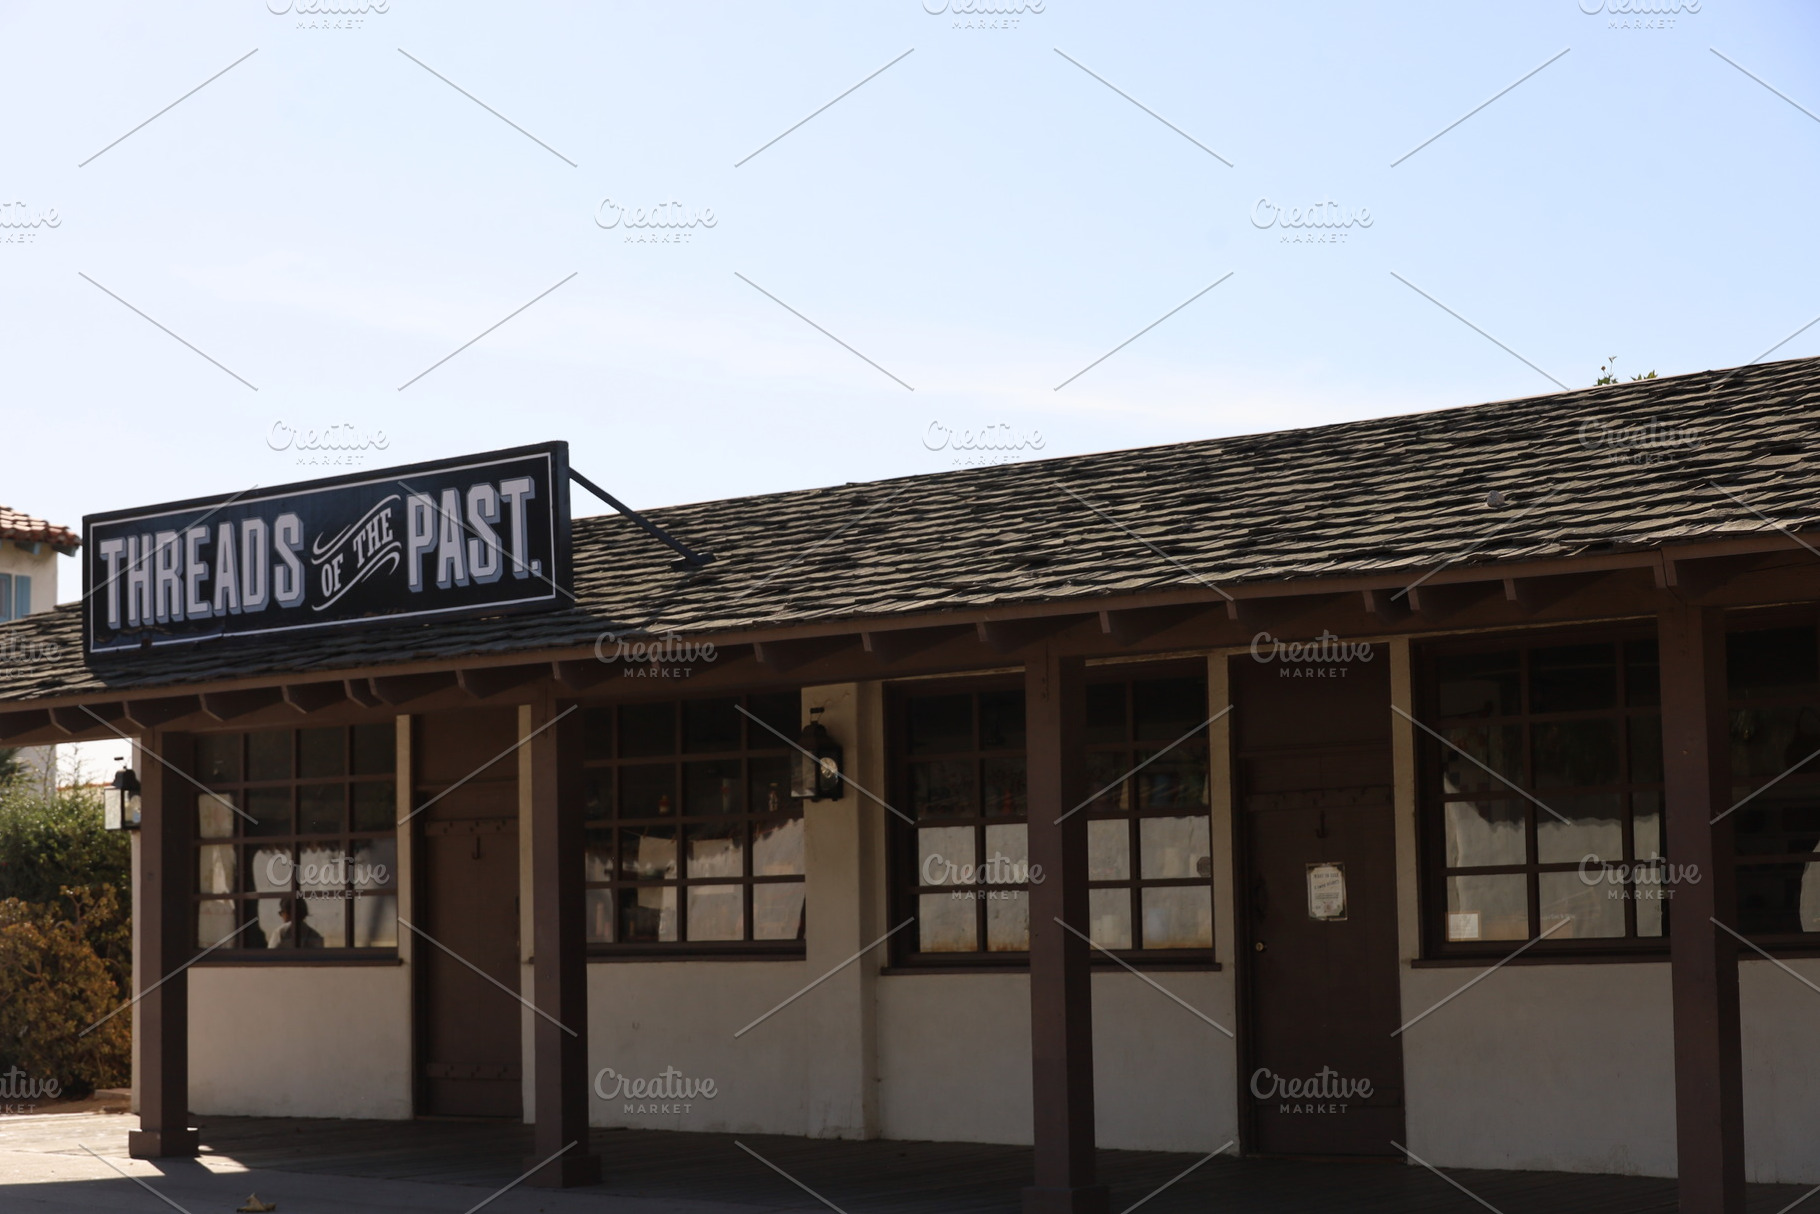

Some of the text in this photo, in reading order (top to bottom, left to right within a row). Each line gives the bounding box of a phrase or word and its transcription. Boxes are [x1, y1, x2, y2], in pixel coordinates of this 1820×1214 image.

[100, 476, 542, 629] THREADS OF THE PAST.
